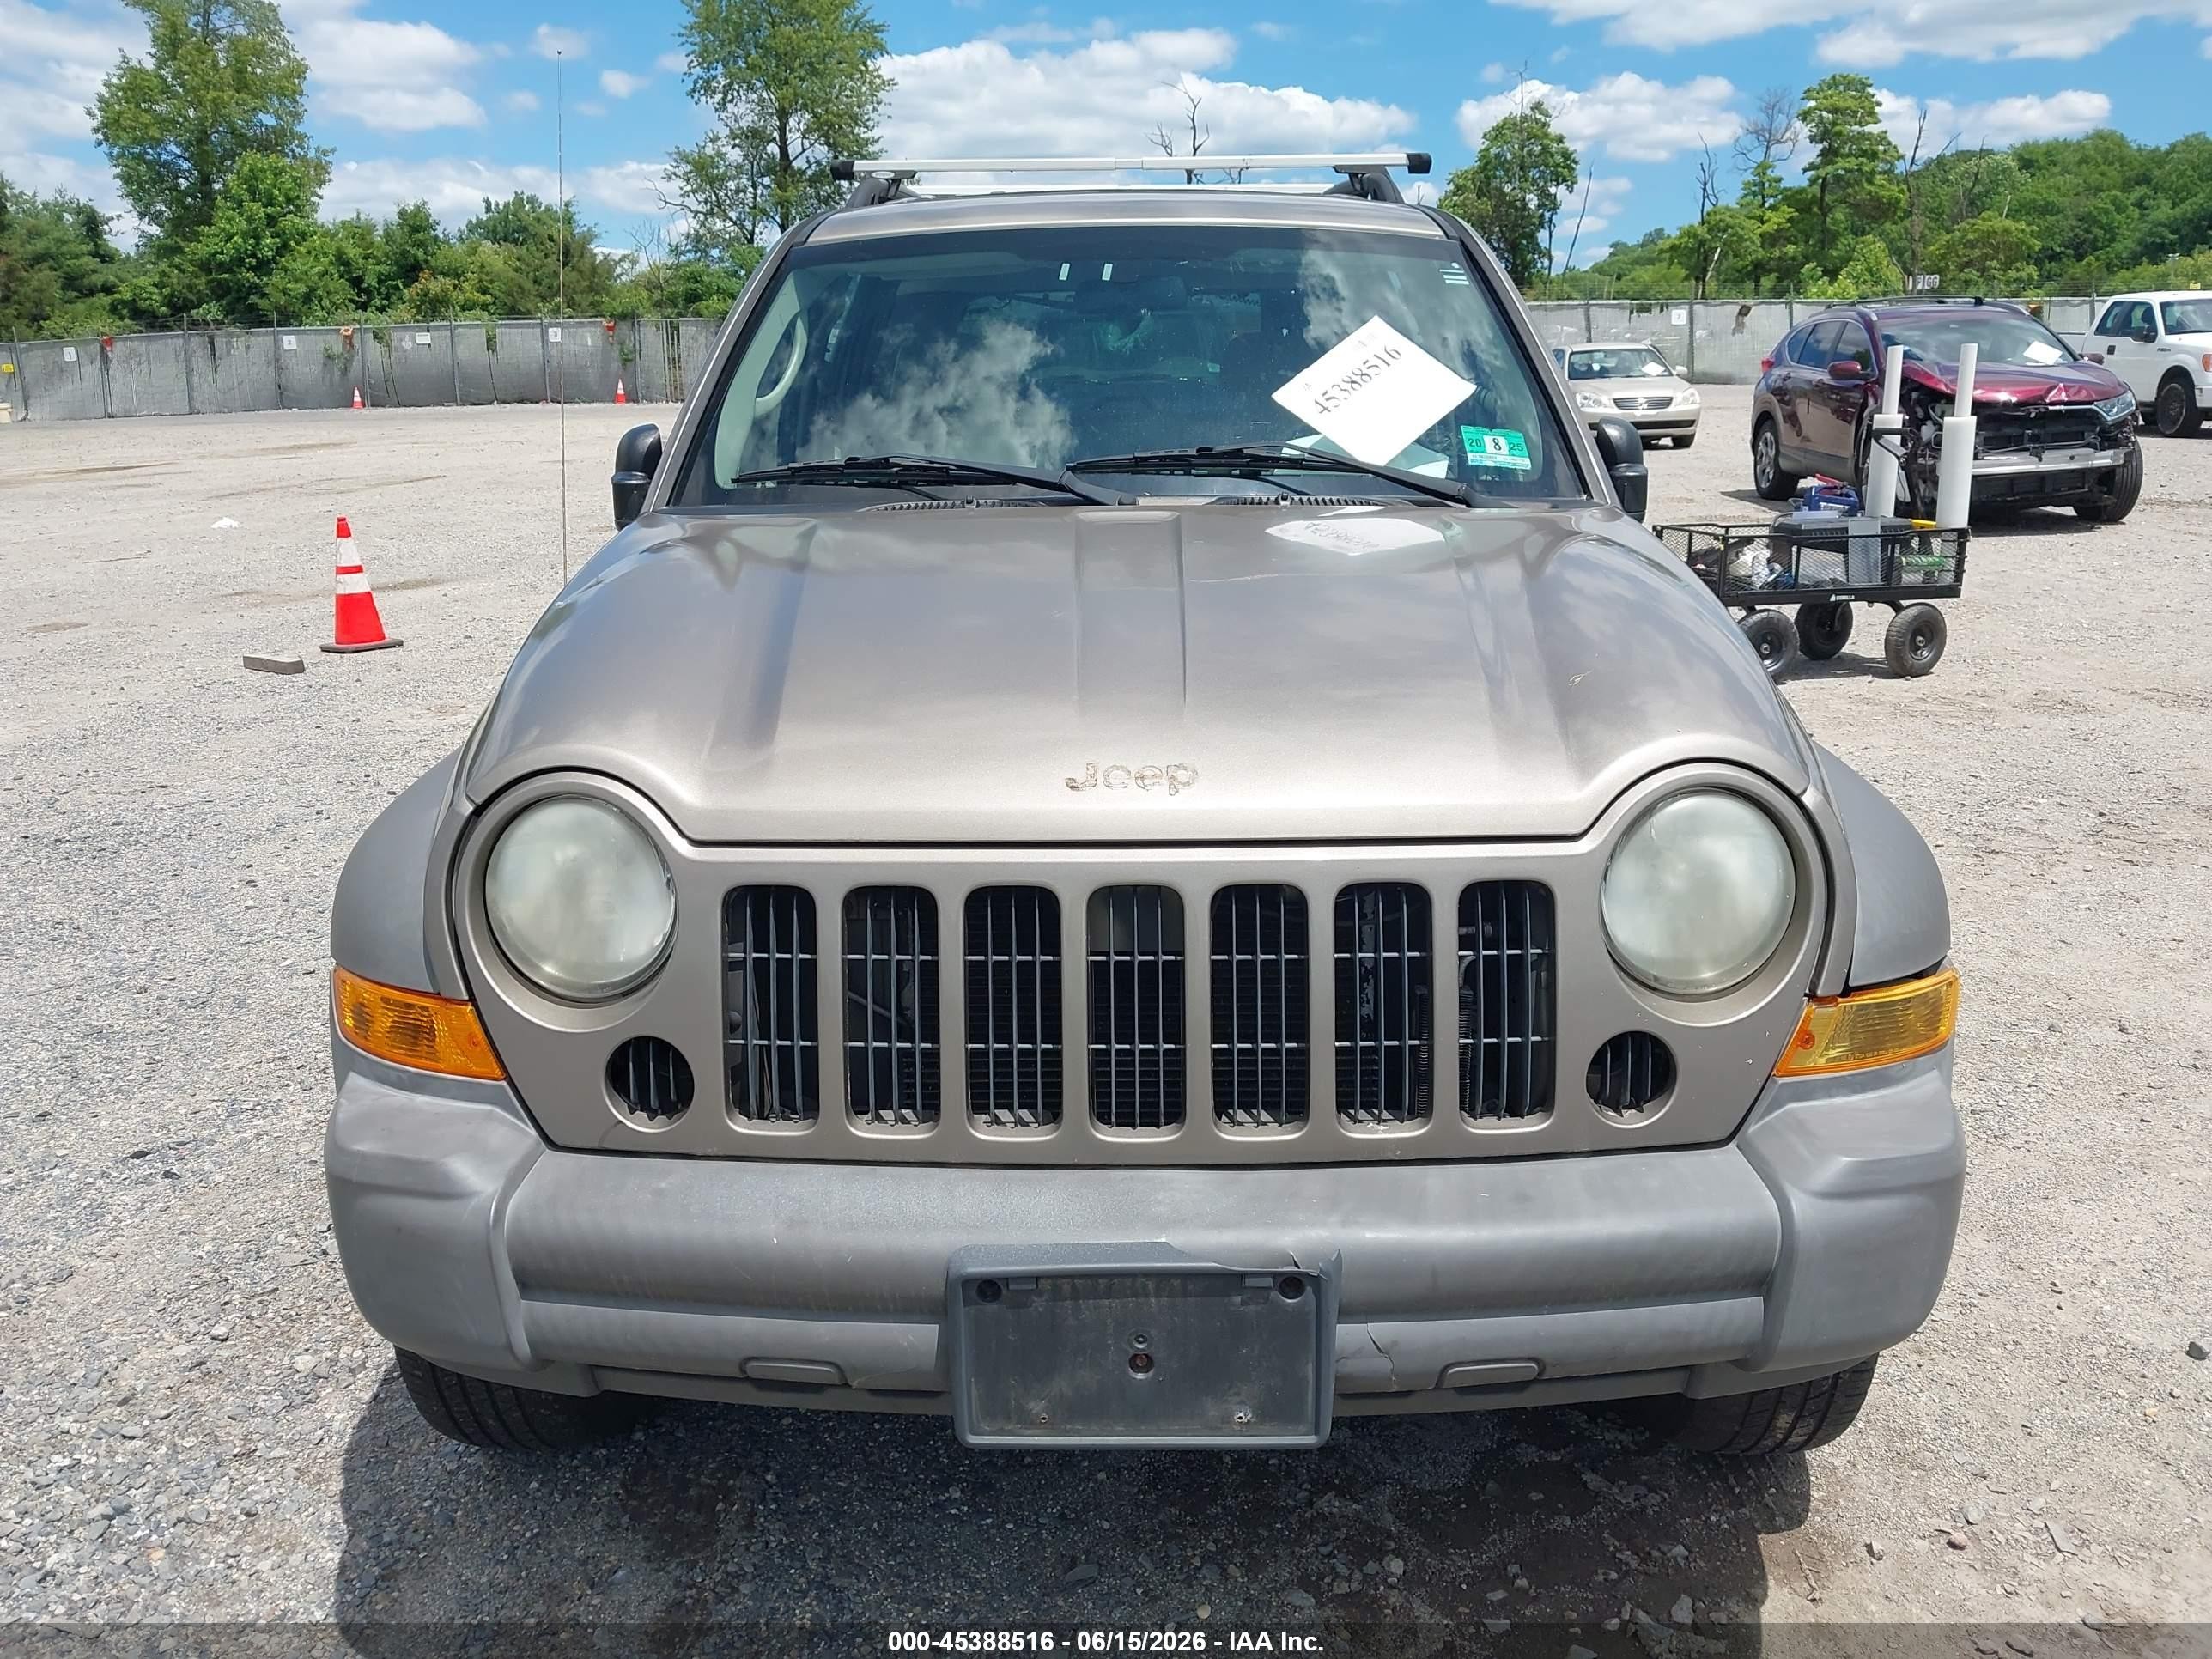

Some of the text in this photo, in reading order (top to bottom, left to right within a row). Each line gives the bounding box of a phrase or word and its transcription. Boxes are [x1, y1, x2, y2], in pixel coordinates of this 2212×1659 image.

[1314, 344, 1402, 414] 45388516
[1468, 437, 1524, 452] 20 8 25
[1065, 761, 1199, 797] Jeep
